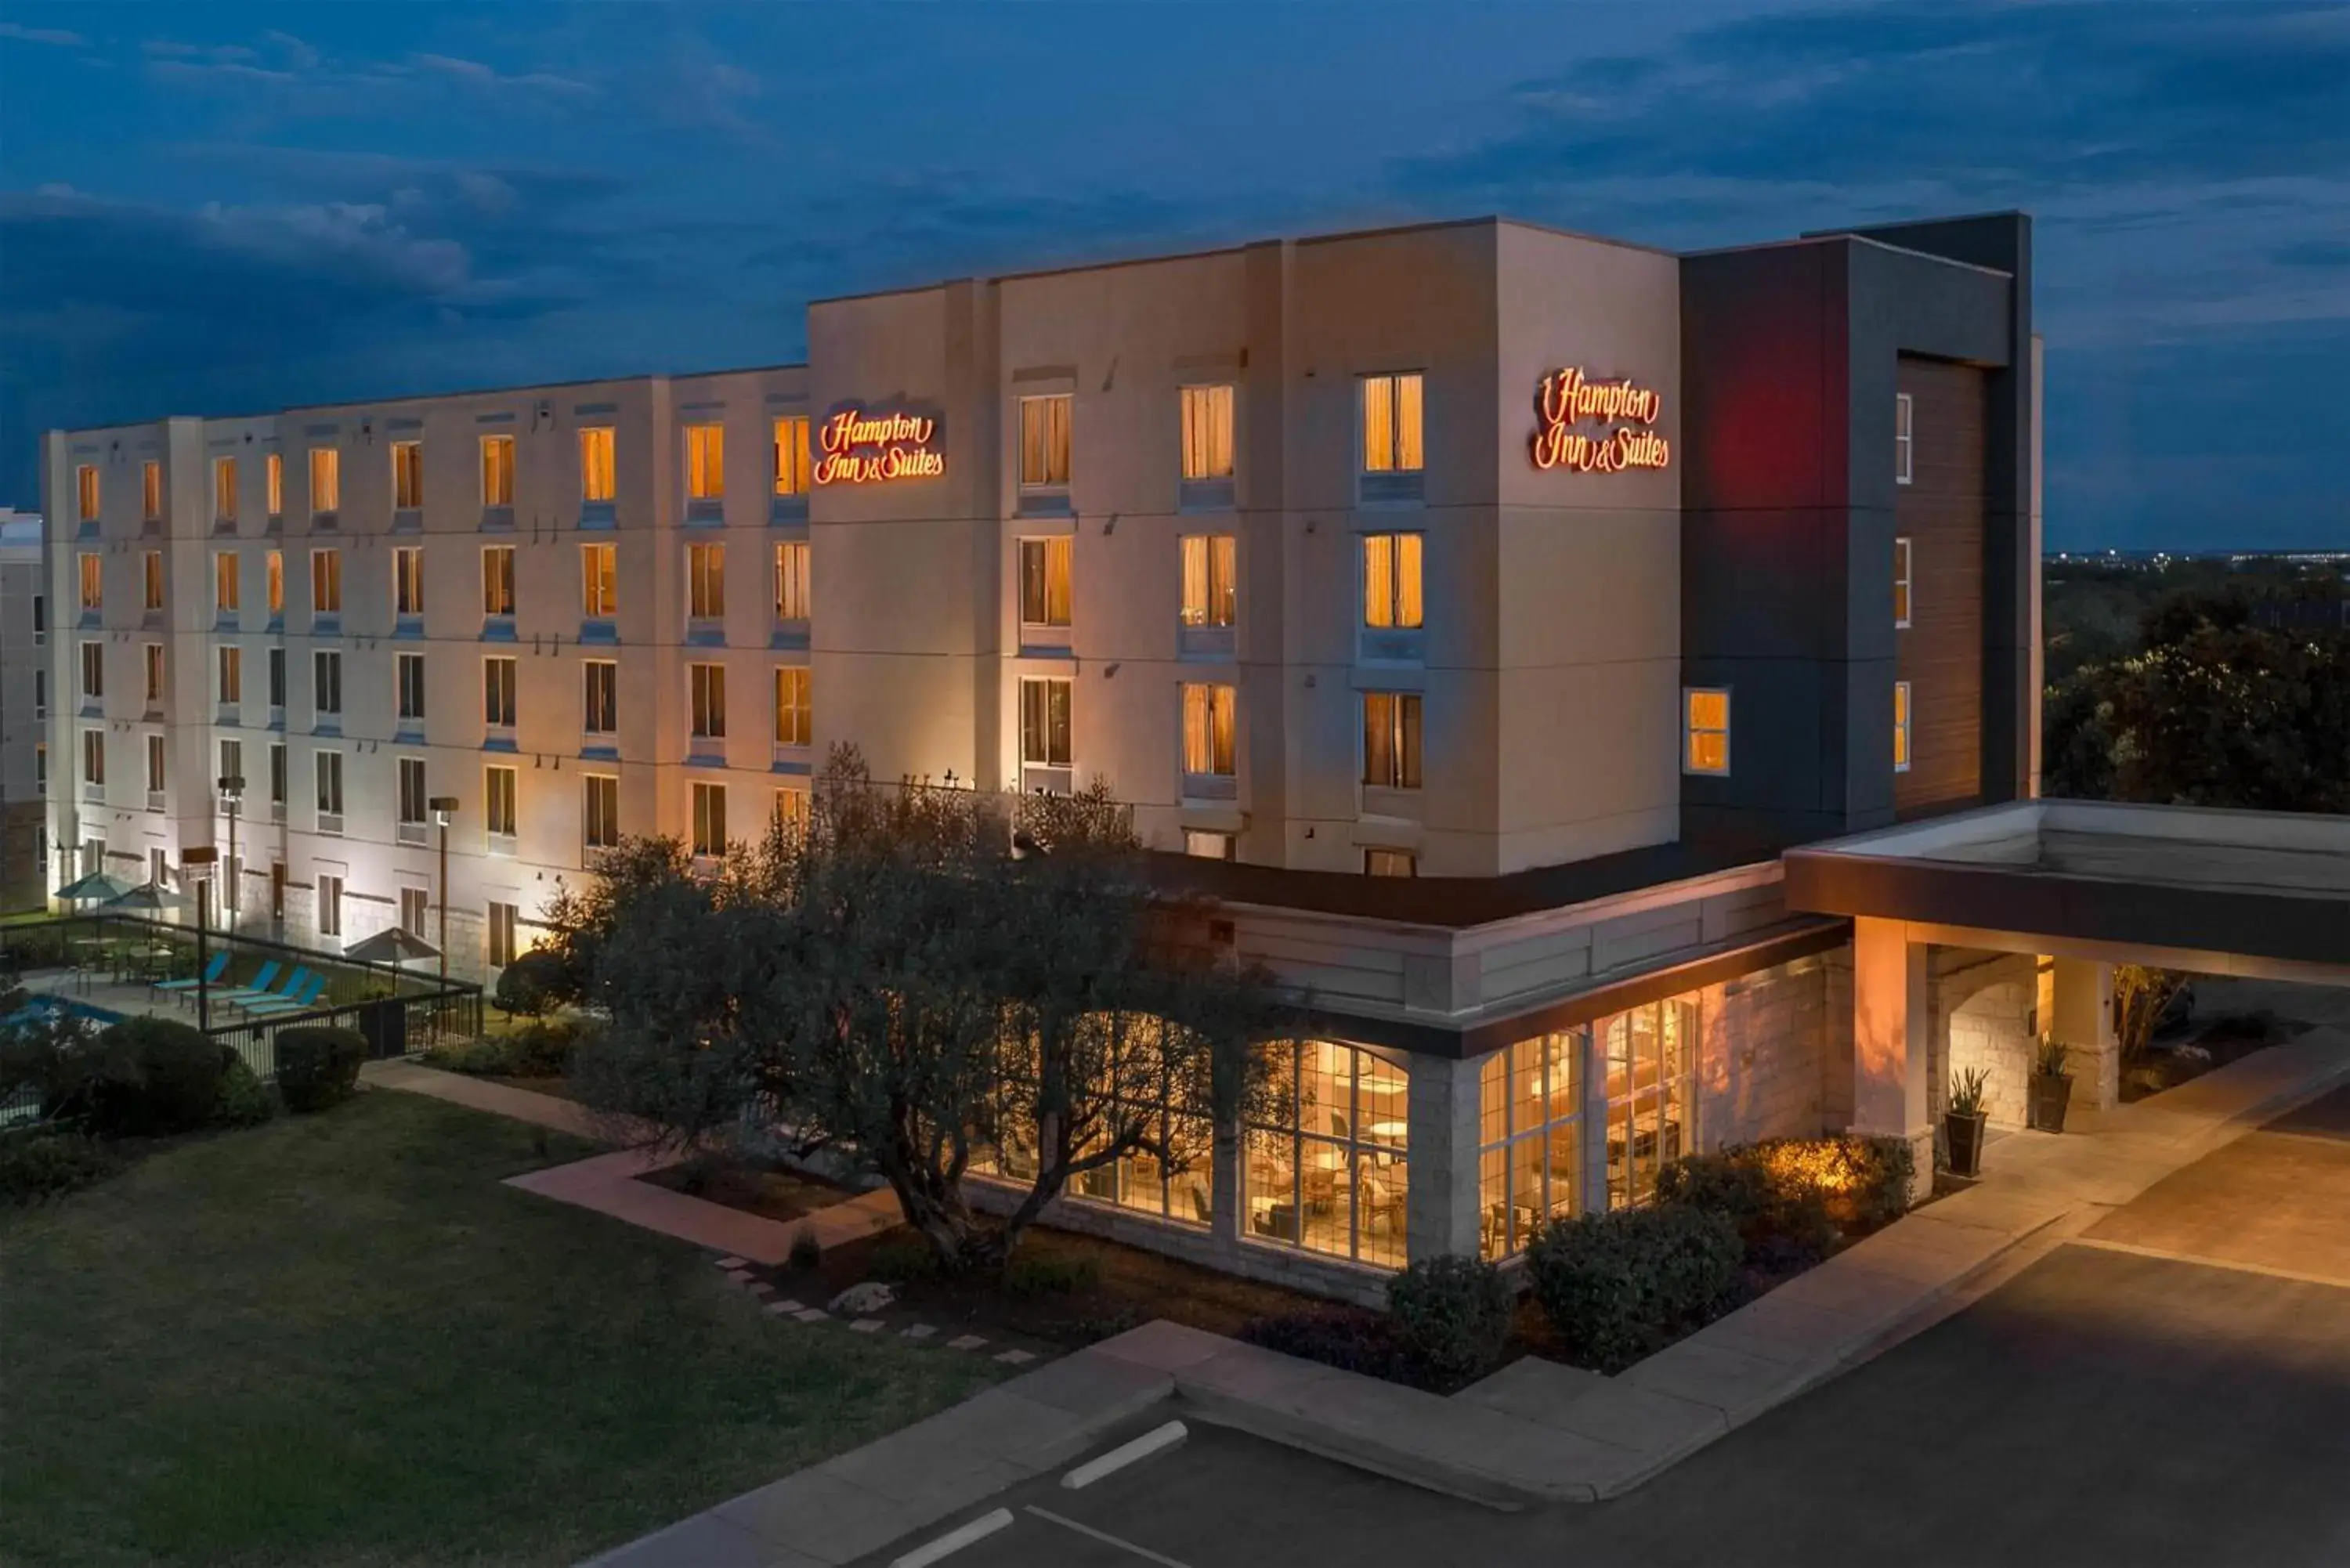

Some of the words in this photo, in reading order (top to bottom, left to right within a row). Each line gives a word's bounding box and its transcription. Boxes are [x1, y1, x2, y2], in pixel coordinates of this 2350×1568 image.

[1543, 366, 1660, 425] Hampton
[821, 410, 933, 452] Hampton
[1535, 421, 1598, 472] Inn
[1610, 427, 1669, 469] Suites
[815, 452, 870, 484] Inn
[881, 447, 943, 478] Suites
